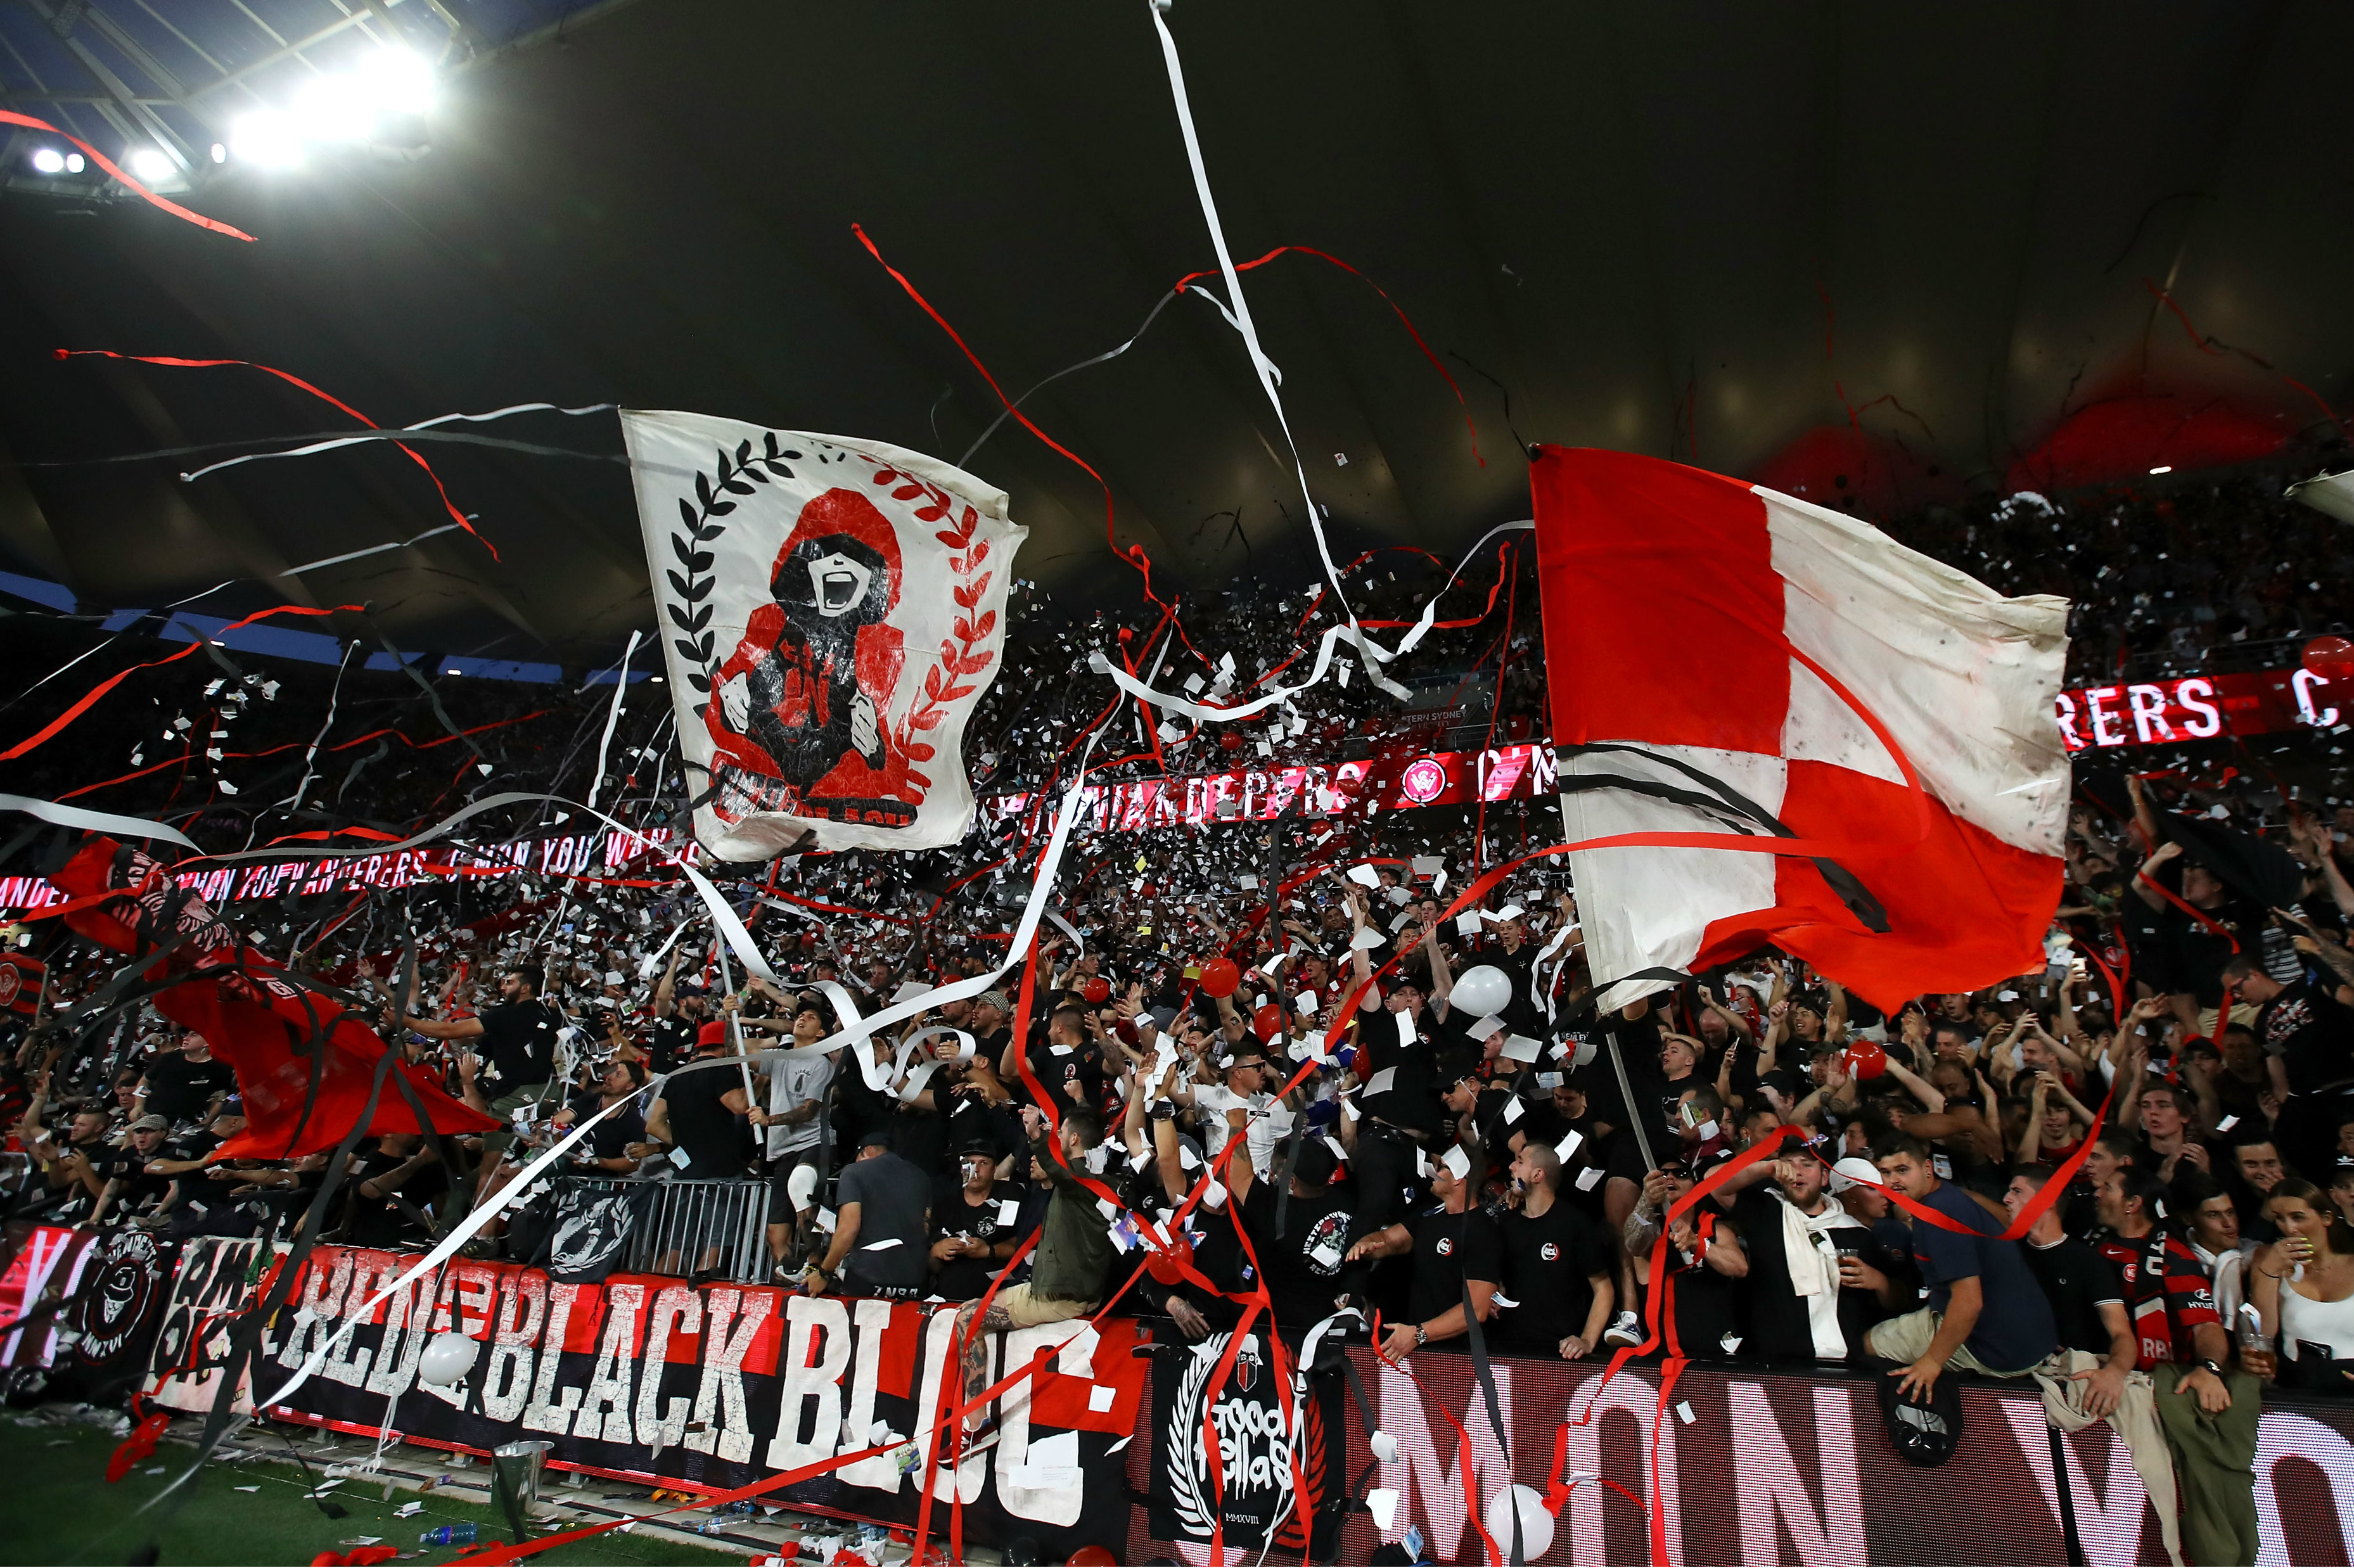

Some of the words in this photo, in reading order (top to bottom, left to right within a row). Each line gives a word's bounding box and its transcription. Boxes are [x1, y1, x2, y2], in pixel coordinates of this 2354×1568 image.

[1431, 709, 1467, 721] SYDNEY
[541, 834, 593, 875] YOU
[482, 1269, 774, 1464] BLACK
[765, 1295, 1095, 1527] BLOC
[1225, 1513, 1259, 1524] MMXVIII
